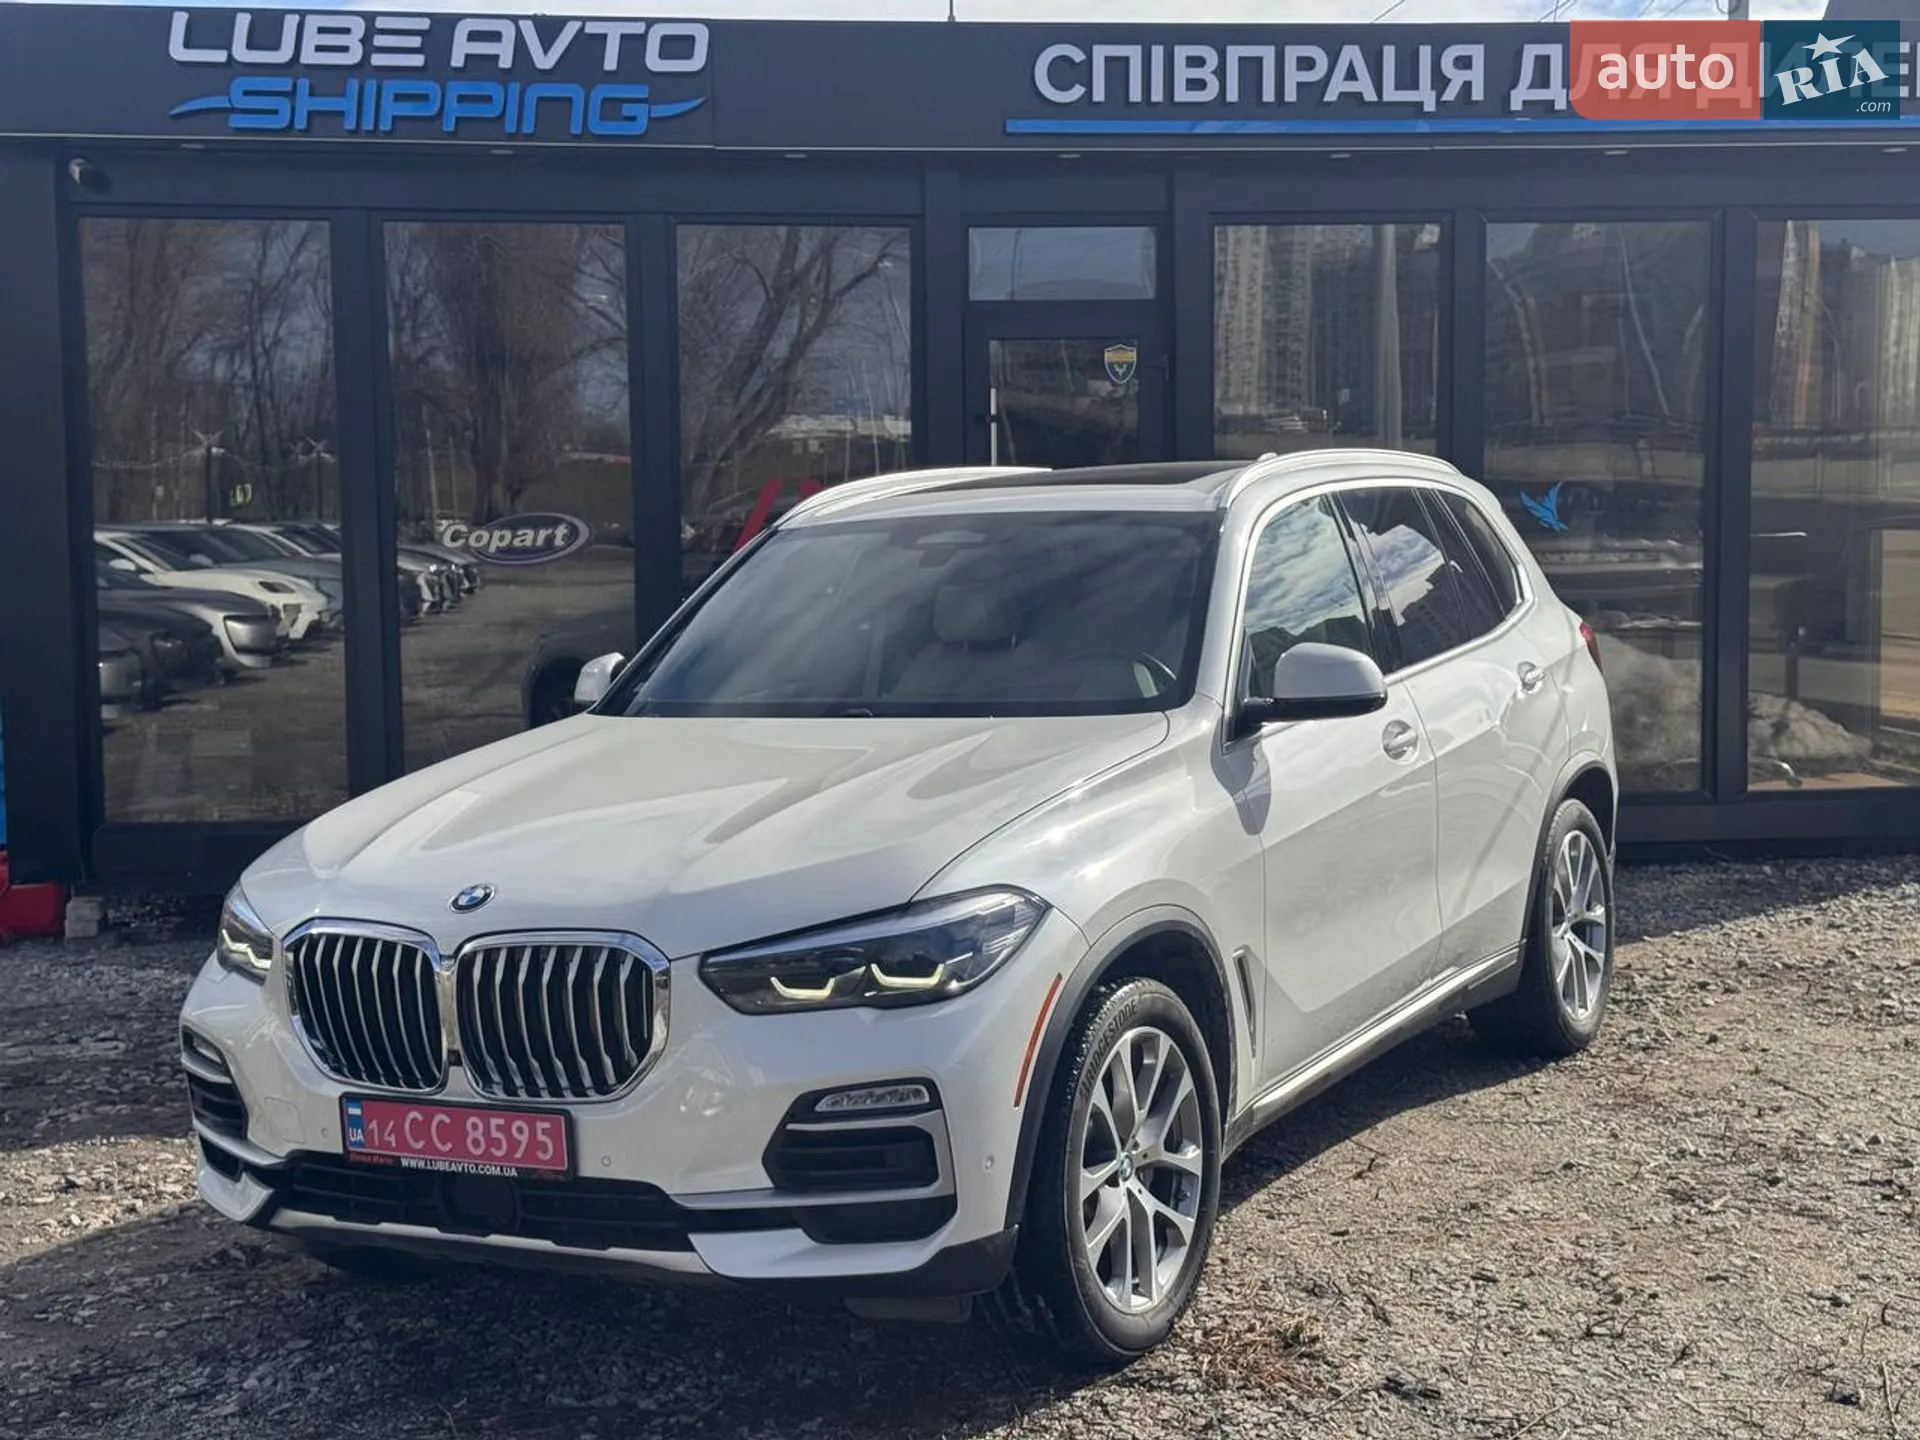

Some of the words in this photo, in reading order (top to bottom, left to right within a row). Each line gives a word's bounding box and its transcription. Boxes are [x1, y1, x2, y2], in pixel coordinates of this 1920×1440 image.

[168, 11, 431, 68] LUBE
[451, 18, 709, 73] AVTO
[1034, 43, 1485, 112] СПІВПРАЦЯ
[228, 77, 649, 136] SHIPPING
[443, 523, 568, 553] Copart
[349, 1127, 365, 1143] UA
[465, 1116, 553, 1161] 8595
[400, 1158, 518, 1177] WWW.LUBEAVTO.COM.UA
